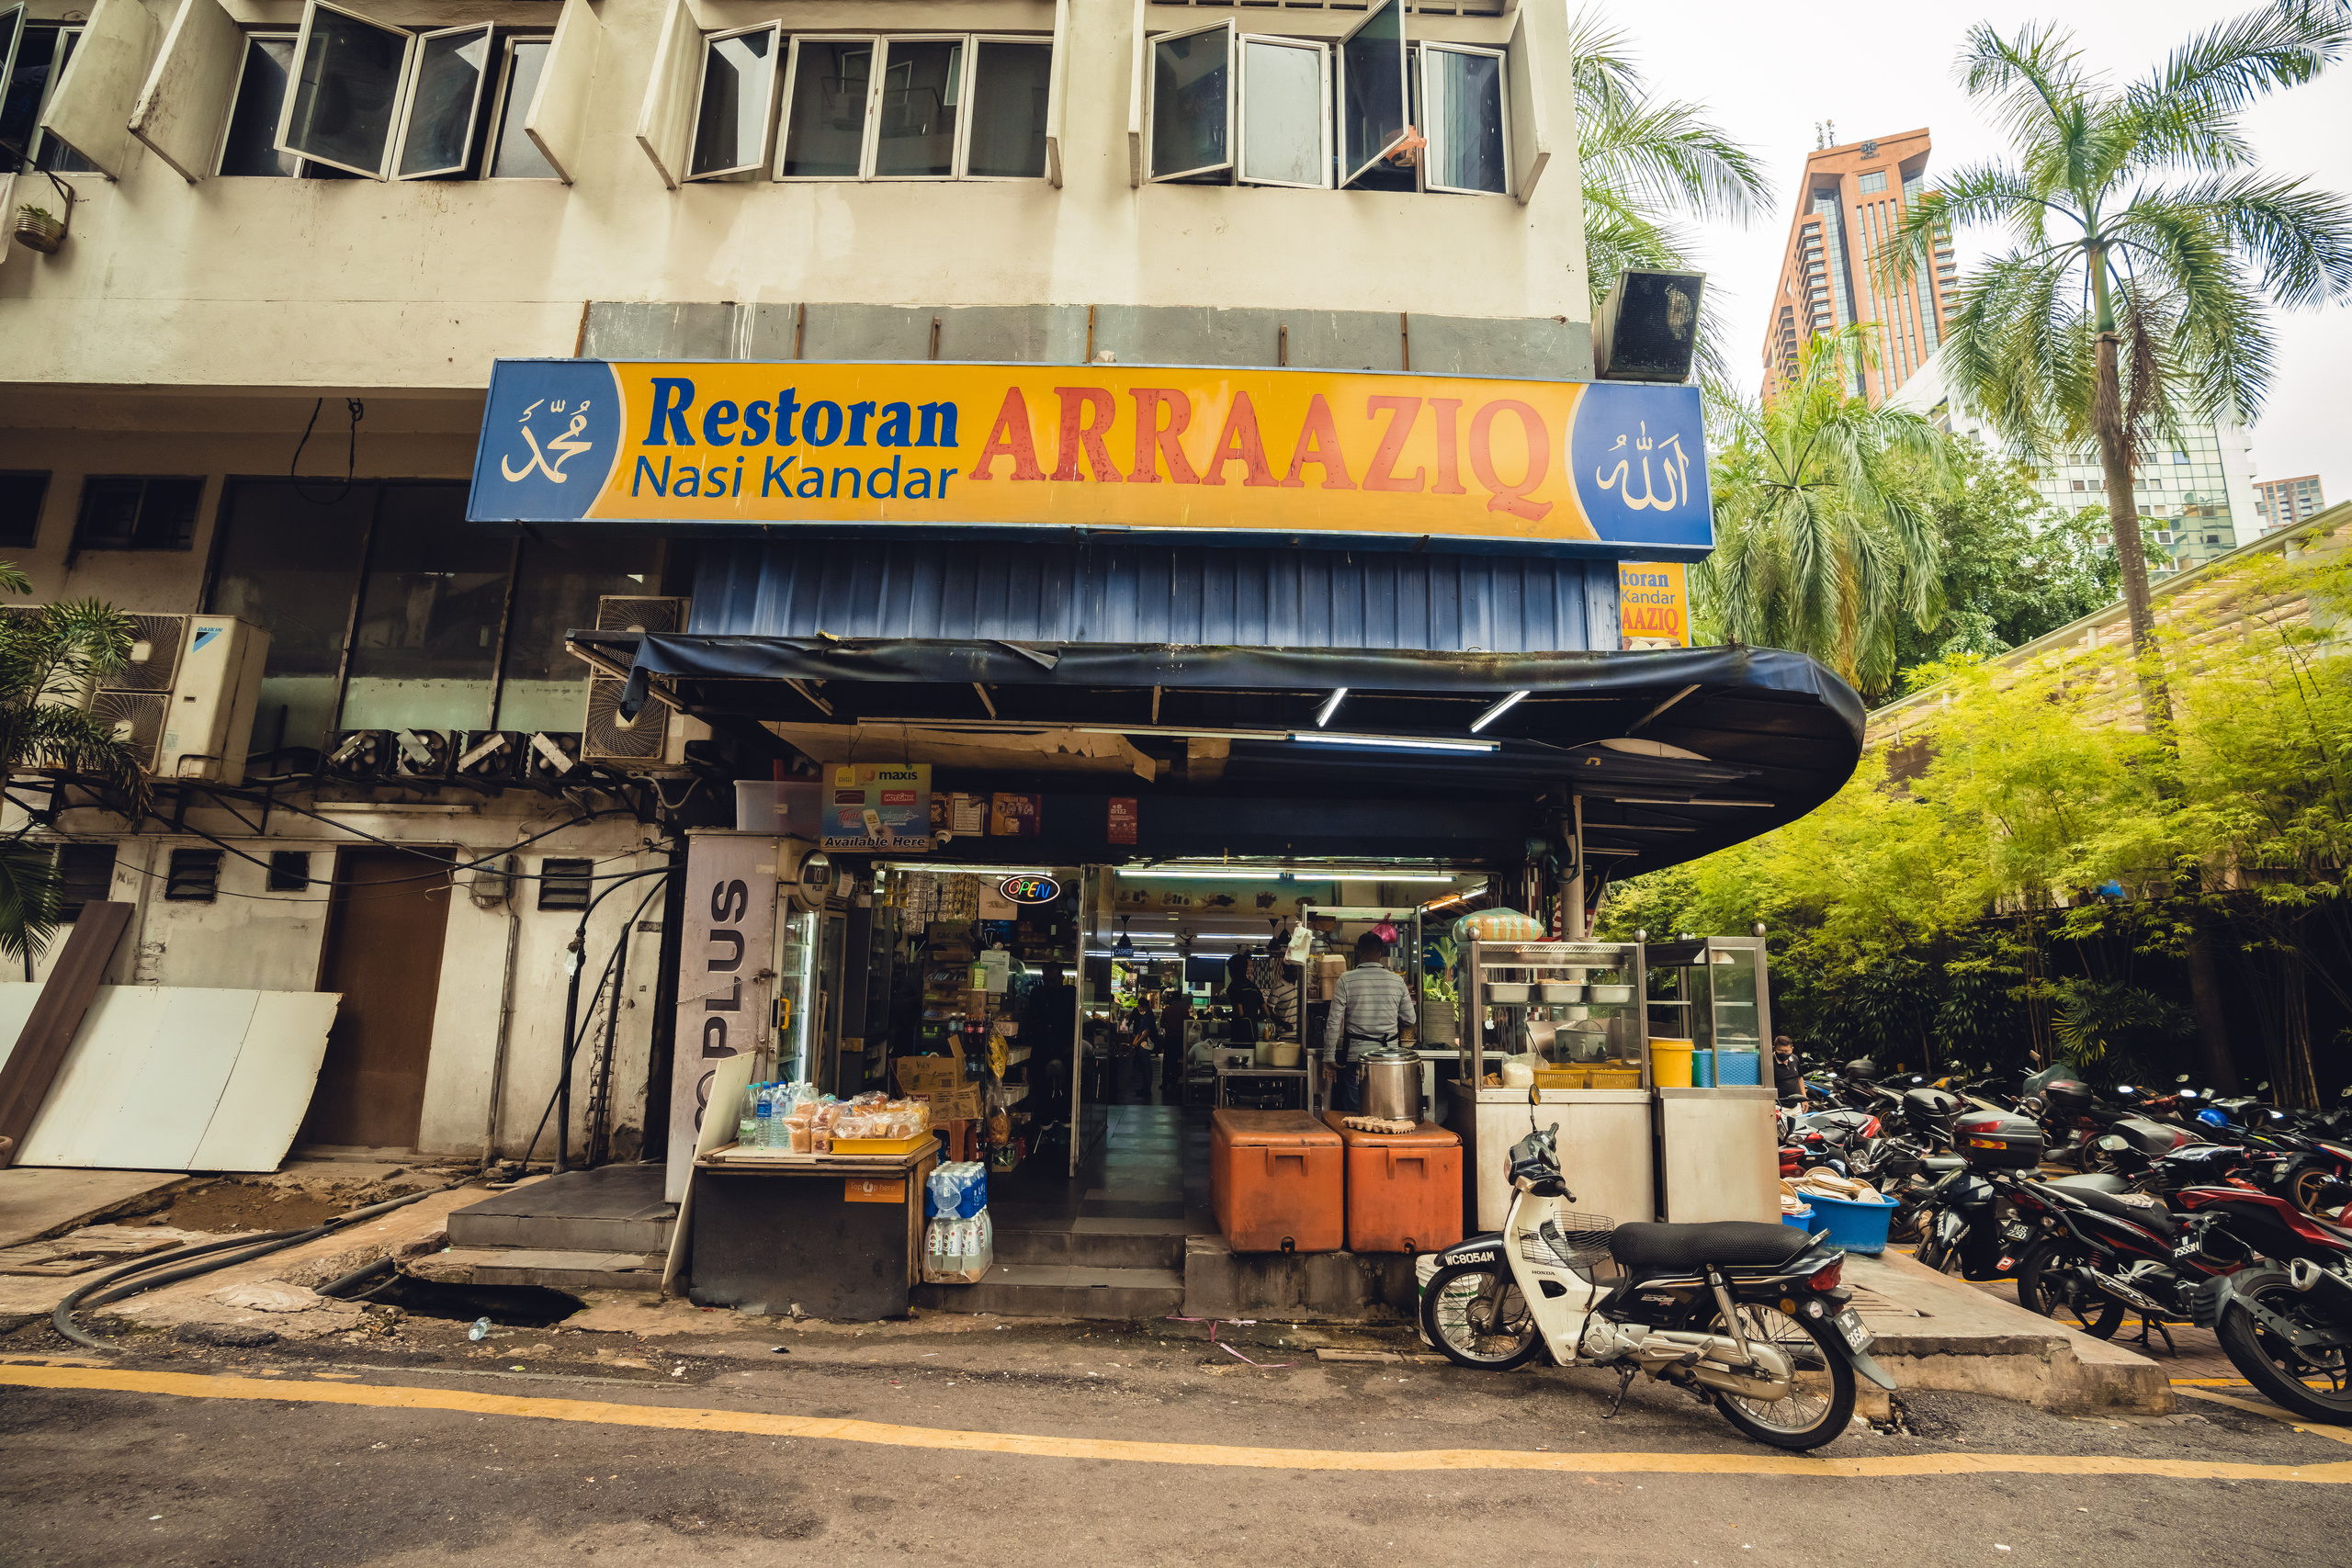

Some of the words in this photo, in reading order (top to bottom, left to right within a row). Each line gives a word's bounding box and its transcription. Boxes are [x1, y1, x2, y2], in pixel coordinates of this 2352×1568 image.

[642, 377, 958, 447] Restoran
[968, 386, 1553, 520] ARRAAZIQ
[632, 454, 745, 498] Nasi
[762, 454, 958, 500] Kandar
[1622, 589, 1676, 604] Kandar
[879, 772, 918, 781] maxis
[837, 808, 862, 825] Tune
[824, 836, 888, 848] Available
[892, 836, 925, 847] Here
[1008, 879, 1051, 898] OPEN
[1114, 947, 1134, 955] CASHIER
[702, 879, 749, 1060] PLUS
[850, 1182, 862, 1191] Top
[1445, 1251, 1495, 1266] WC8054M
[1996, 1258, 2012, 1268] P
